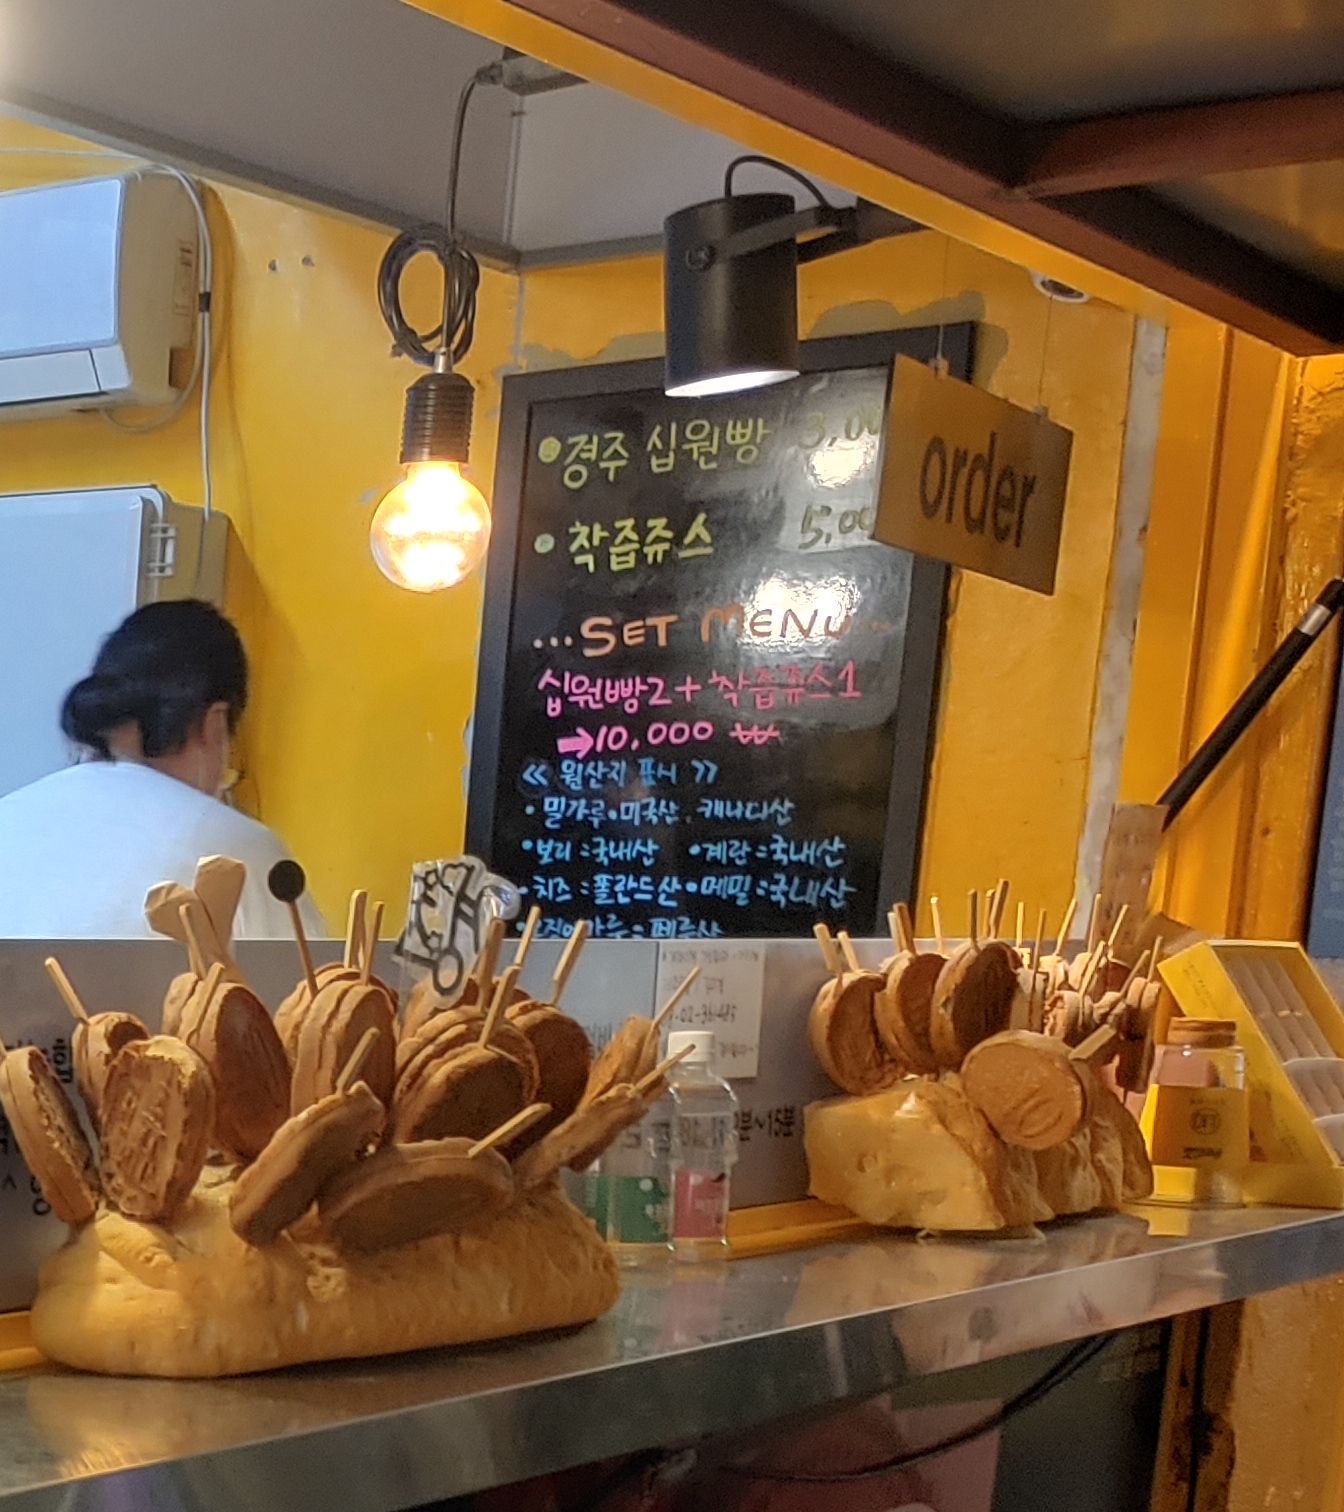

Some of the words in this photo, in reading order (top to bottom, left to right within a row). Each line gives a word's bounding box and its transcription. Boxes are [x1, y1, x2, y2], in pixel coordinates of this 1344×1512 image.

[563, 430, 629, 490] 경주
[646, 417, 773, 476] 십원빵
[917, 431, 1038, 550] order
[569, 512, 714, 574] 착즙쥬스
[595, 721, 714, 753] 10,000
